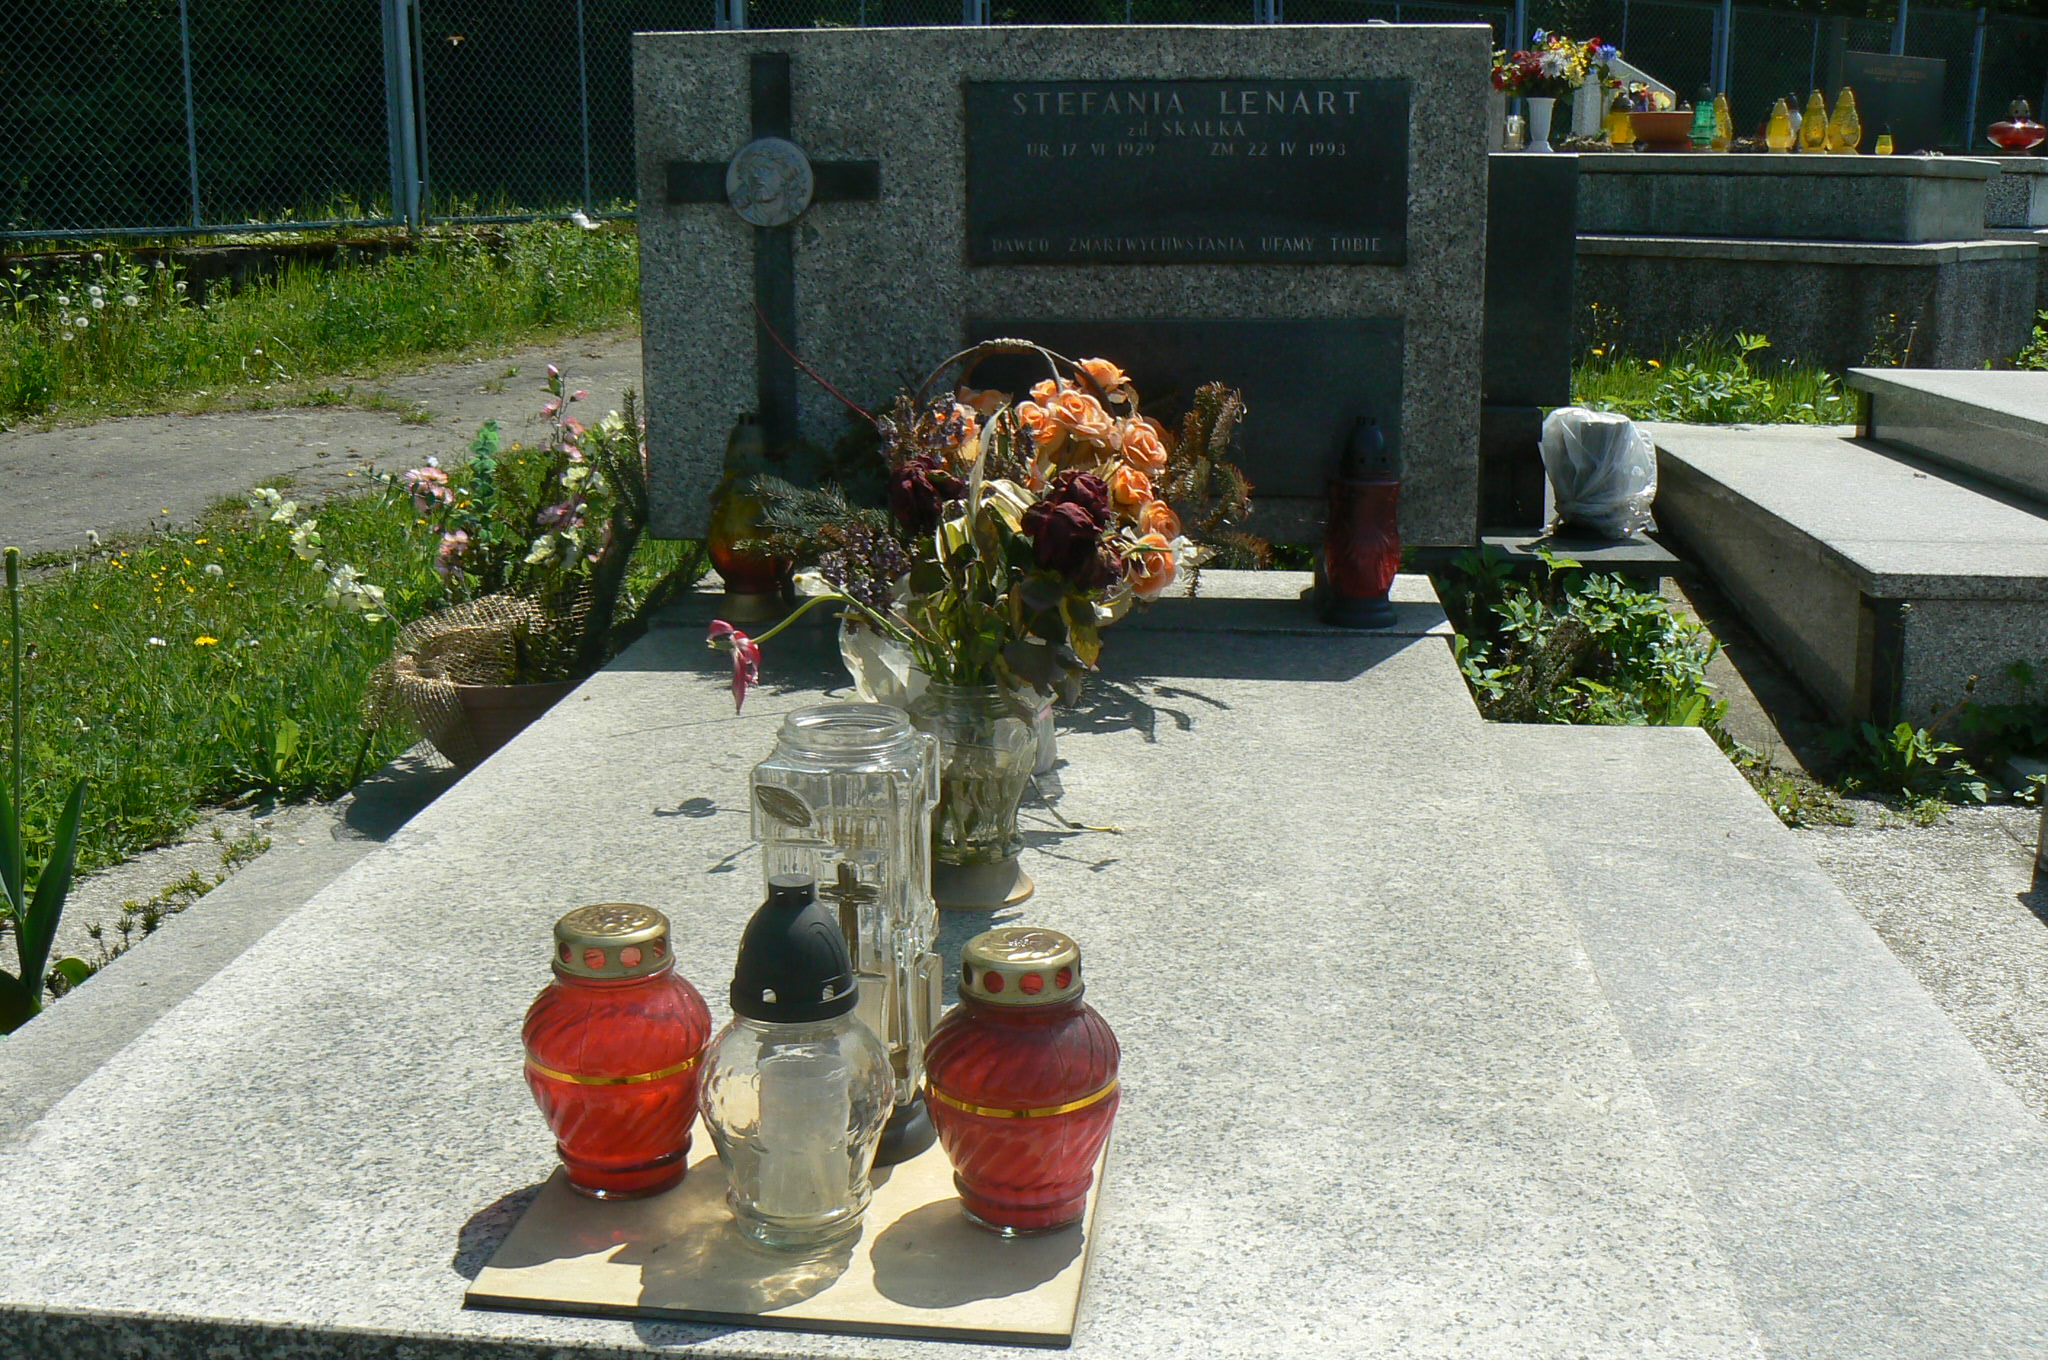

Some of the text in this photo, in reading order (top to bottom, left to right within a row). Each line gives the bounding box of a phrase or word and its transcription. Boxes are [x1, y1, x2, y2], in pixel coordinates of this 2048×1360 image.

[1013, 90, 1361, 115] STEFANIA LENART
[1117, 142, 1155, 156] 1929
[1247, 142, 1268, 156] 22
[1280, 142, 1297, 156] IV
[1308, 142, 1346, 156] 1993
[991, 237, 1382, 252] DAWCO ZMARTWYCHWSTANIA UFAMY TOBIE
